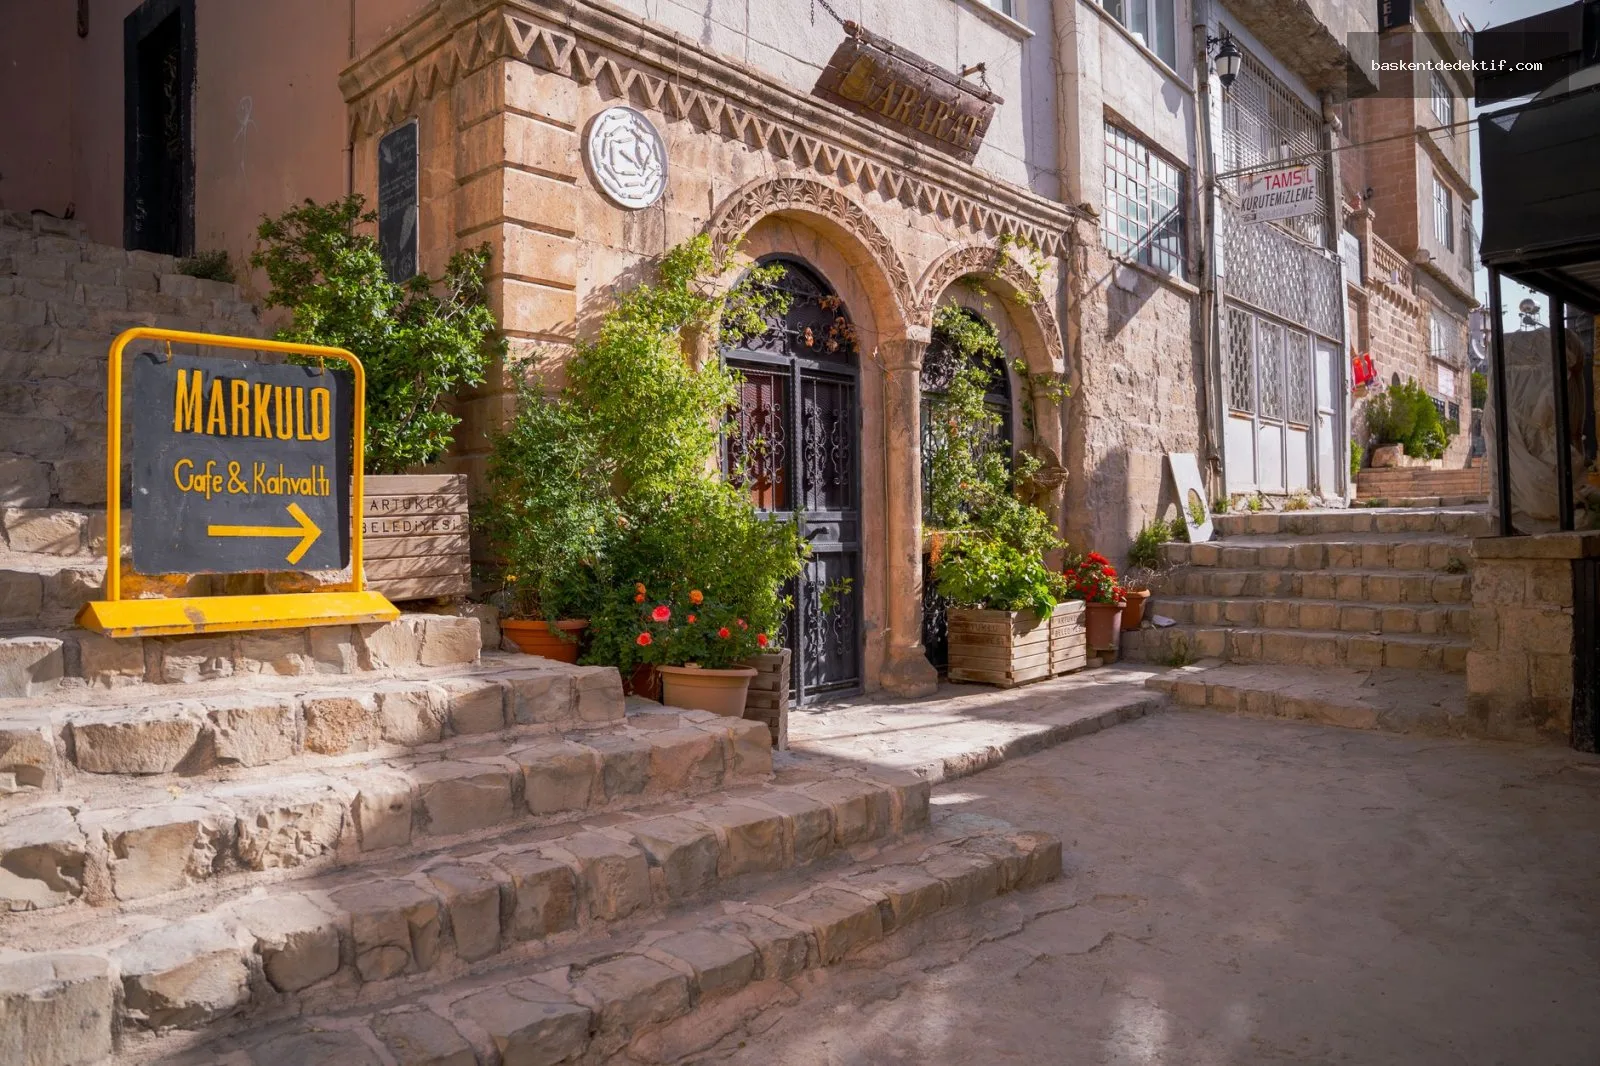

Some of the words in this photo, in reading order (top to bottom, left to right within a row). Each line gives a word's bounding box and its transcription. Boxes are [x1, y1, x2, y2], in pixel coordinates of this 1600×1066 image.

[1383, 0, 1393, 28] EL
[869, 79, 983, 149] ARARAT
[174, 368, 331, 441] MARKULO
[174, 458, 223, 500] Cafe
[227, 460, 249, 494] &
